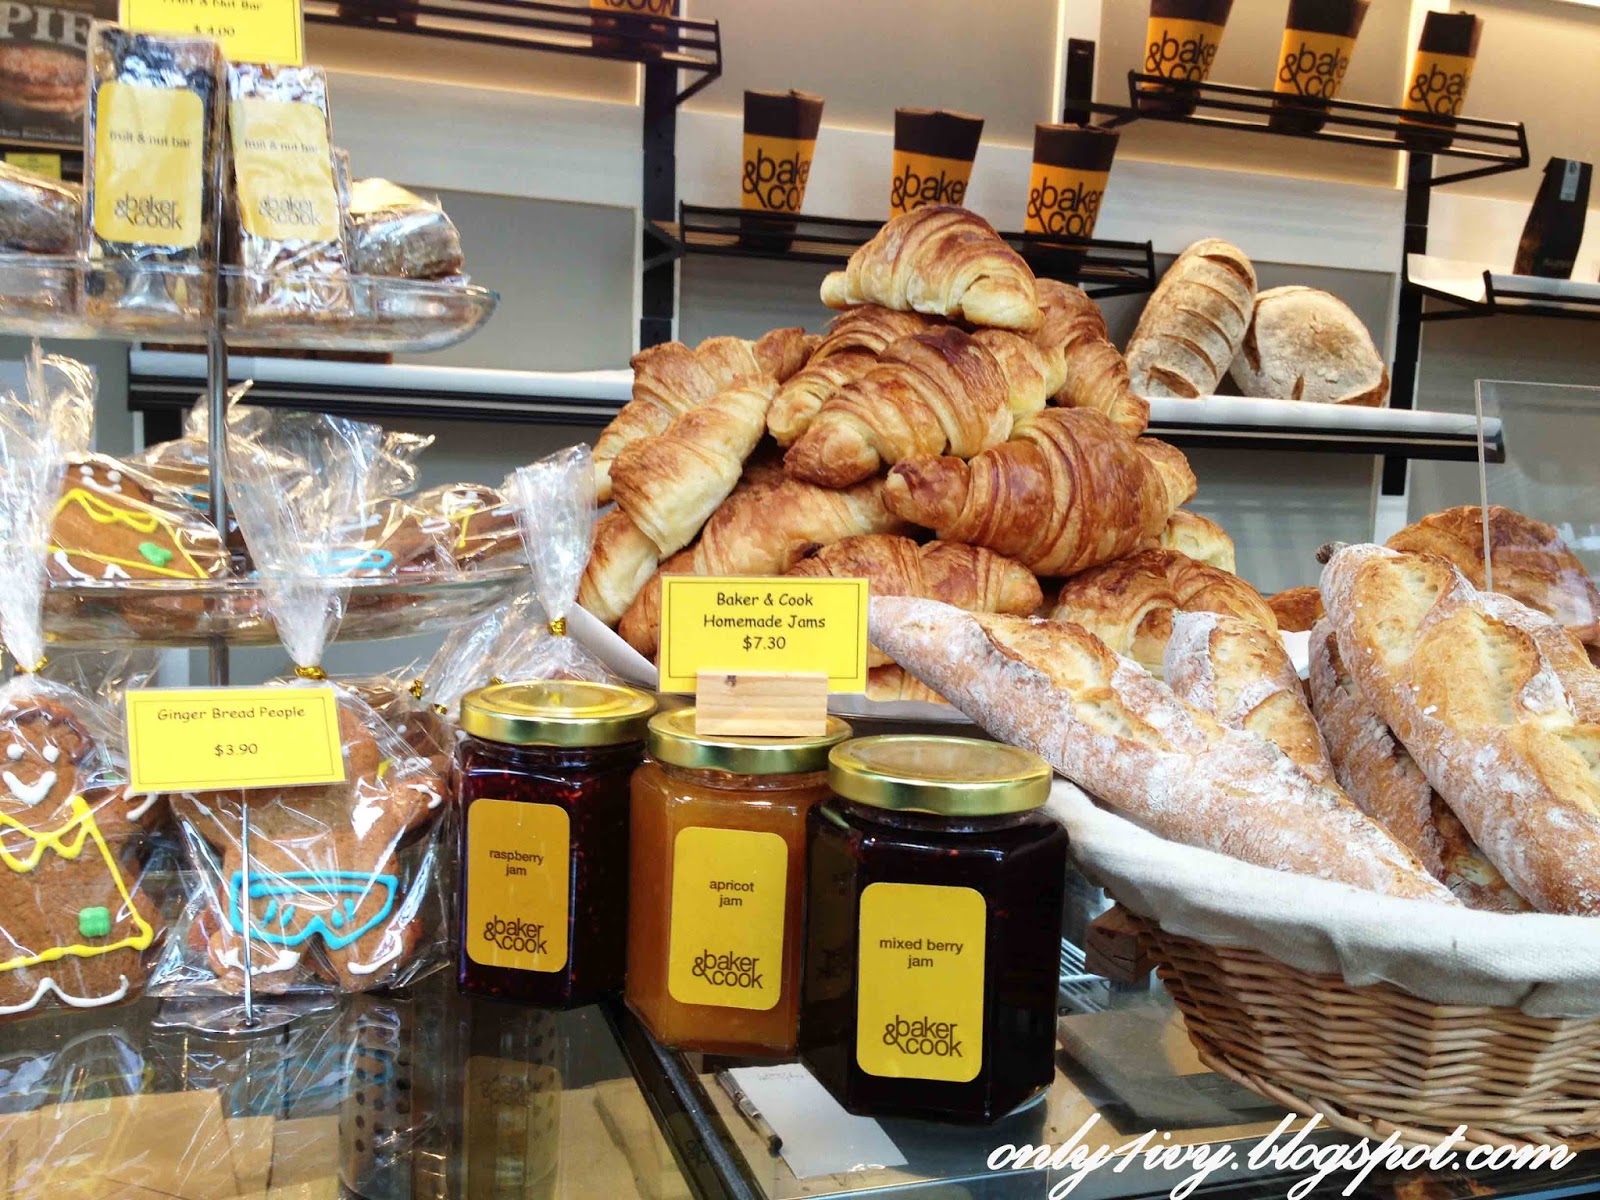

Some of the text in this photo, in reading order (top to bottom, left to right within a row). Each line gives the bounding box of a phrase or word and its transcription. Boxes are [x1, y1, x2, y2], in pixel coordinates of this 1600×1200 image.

[0, 1, 93, 50] PIE
[716, 592, 813, 606] Baker & Cook
[703, 614, 826, 629] Homemade Jams
[742, 635, 786, 652] $7.30
[157, 706, 305, 723] Ginger Bread People
[214, 743, 258, 757] $3.90
[489, 849, 544, 866] raspberry
[505, 864, 527, 877] jam
[709, 880, 755, 893] apricot
[718, 895, 743, 908] jam
[494, 914, 544, 939] baker
[502, 932, 547, 955] cook
[879, 937, 964, 955] mixed berry
[703, 949, 760, 973] baker
[907, 954, 934, 969] jam
[712, 967, 764, 989] cook
[895, 1014, 958, 1040] baker
[906, 1034, 963, 1058] cook
